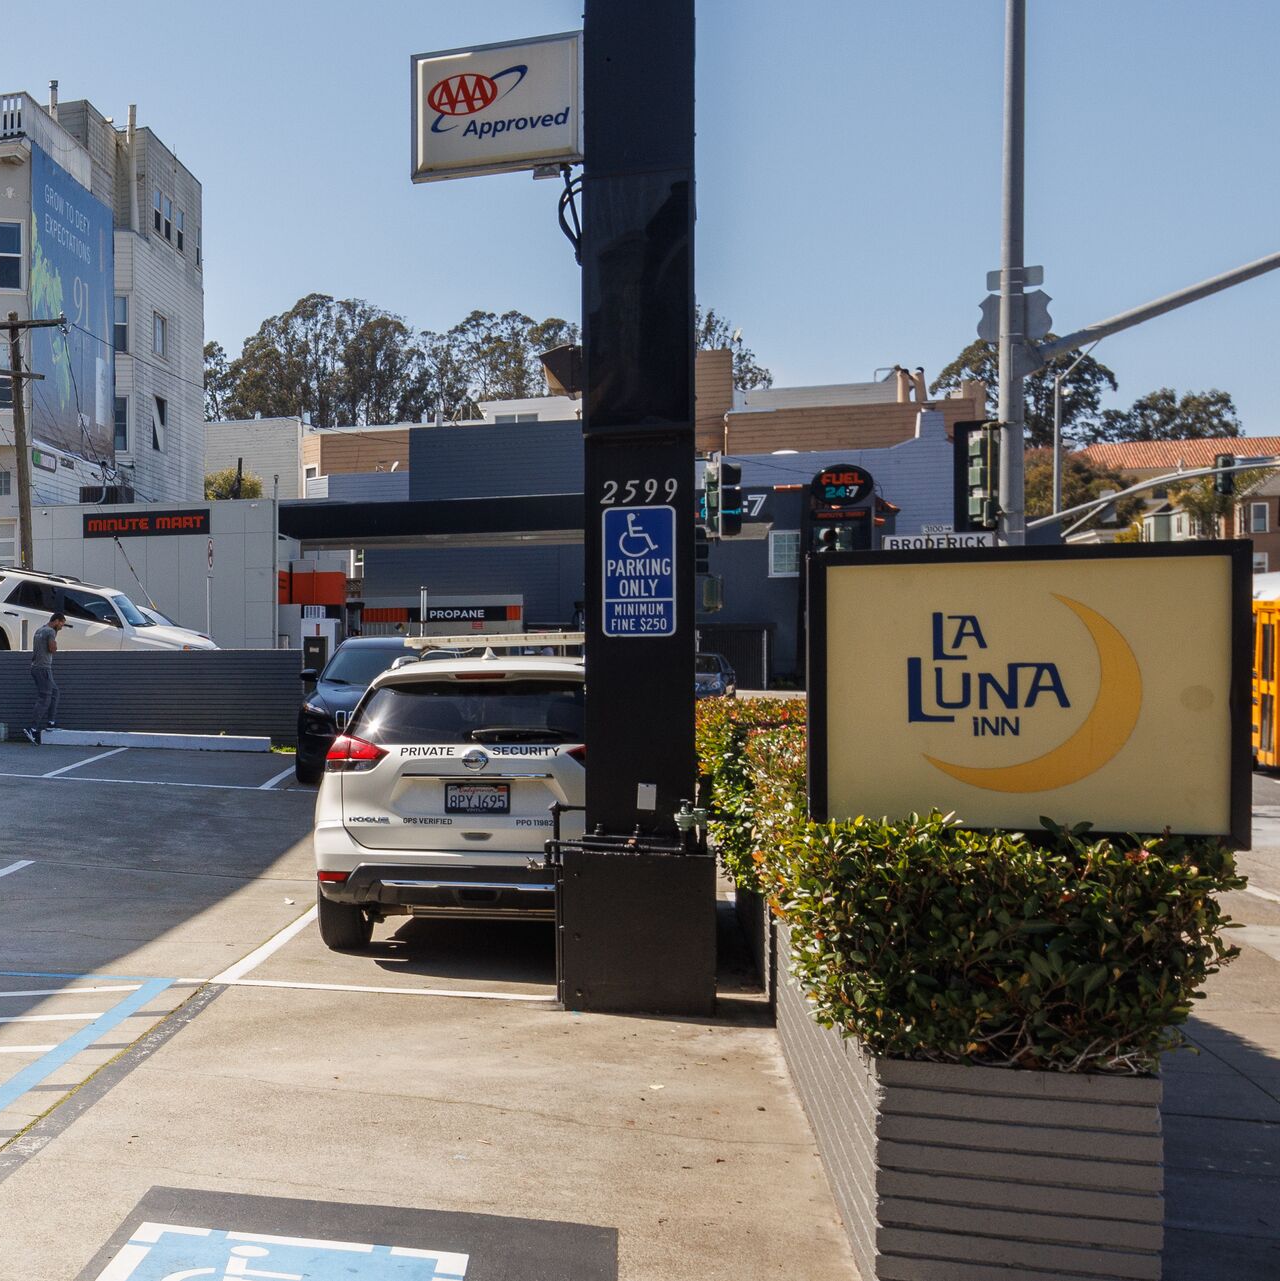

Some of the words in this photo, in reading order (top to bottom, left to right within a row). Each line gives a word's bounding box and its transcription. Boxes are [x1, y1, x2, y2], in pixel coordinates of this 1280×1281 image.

[436, 75, 493, 114] AAA
[462, 107, 570, 139] Approved
[44, 184, 64, 214] GROW
[65, 201, 74, 224] TO
[75, 209, 90, 236] DEFY
[44, 213, 91, 265] EXPECTATIONS
[73, 276, 91, 330] 91
[821, 472, 865, 485] FUEL
[600, 478, 678, 504] 2599
[825, 485, 860, 498] 24:7
[88, 517, 149, 532] MINUTE
[155, 515, 204, 529] MART
[889, 536, 987, 550] BRODERICK
[607, 558, 671, 577] PARKING
[619, 579, 658, 597] ONLY
[429, 609, 485, 619] PROPANE
[614, 603, 664, 616] MINIMUM
[611, 619, 635, 630] FINE
[640, 618, 667, 631] $250
[932, 612, 988, 660] LA
[907, 657, 1071, 723] LUNA
[400, 746, 455, 757] PRIVATE
[492, 746, 560, 757] SECURITY
[450, 794, 505, 809] 8PYJ695
[419, 817, 453, 825] VERIFIED
